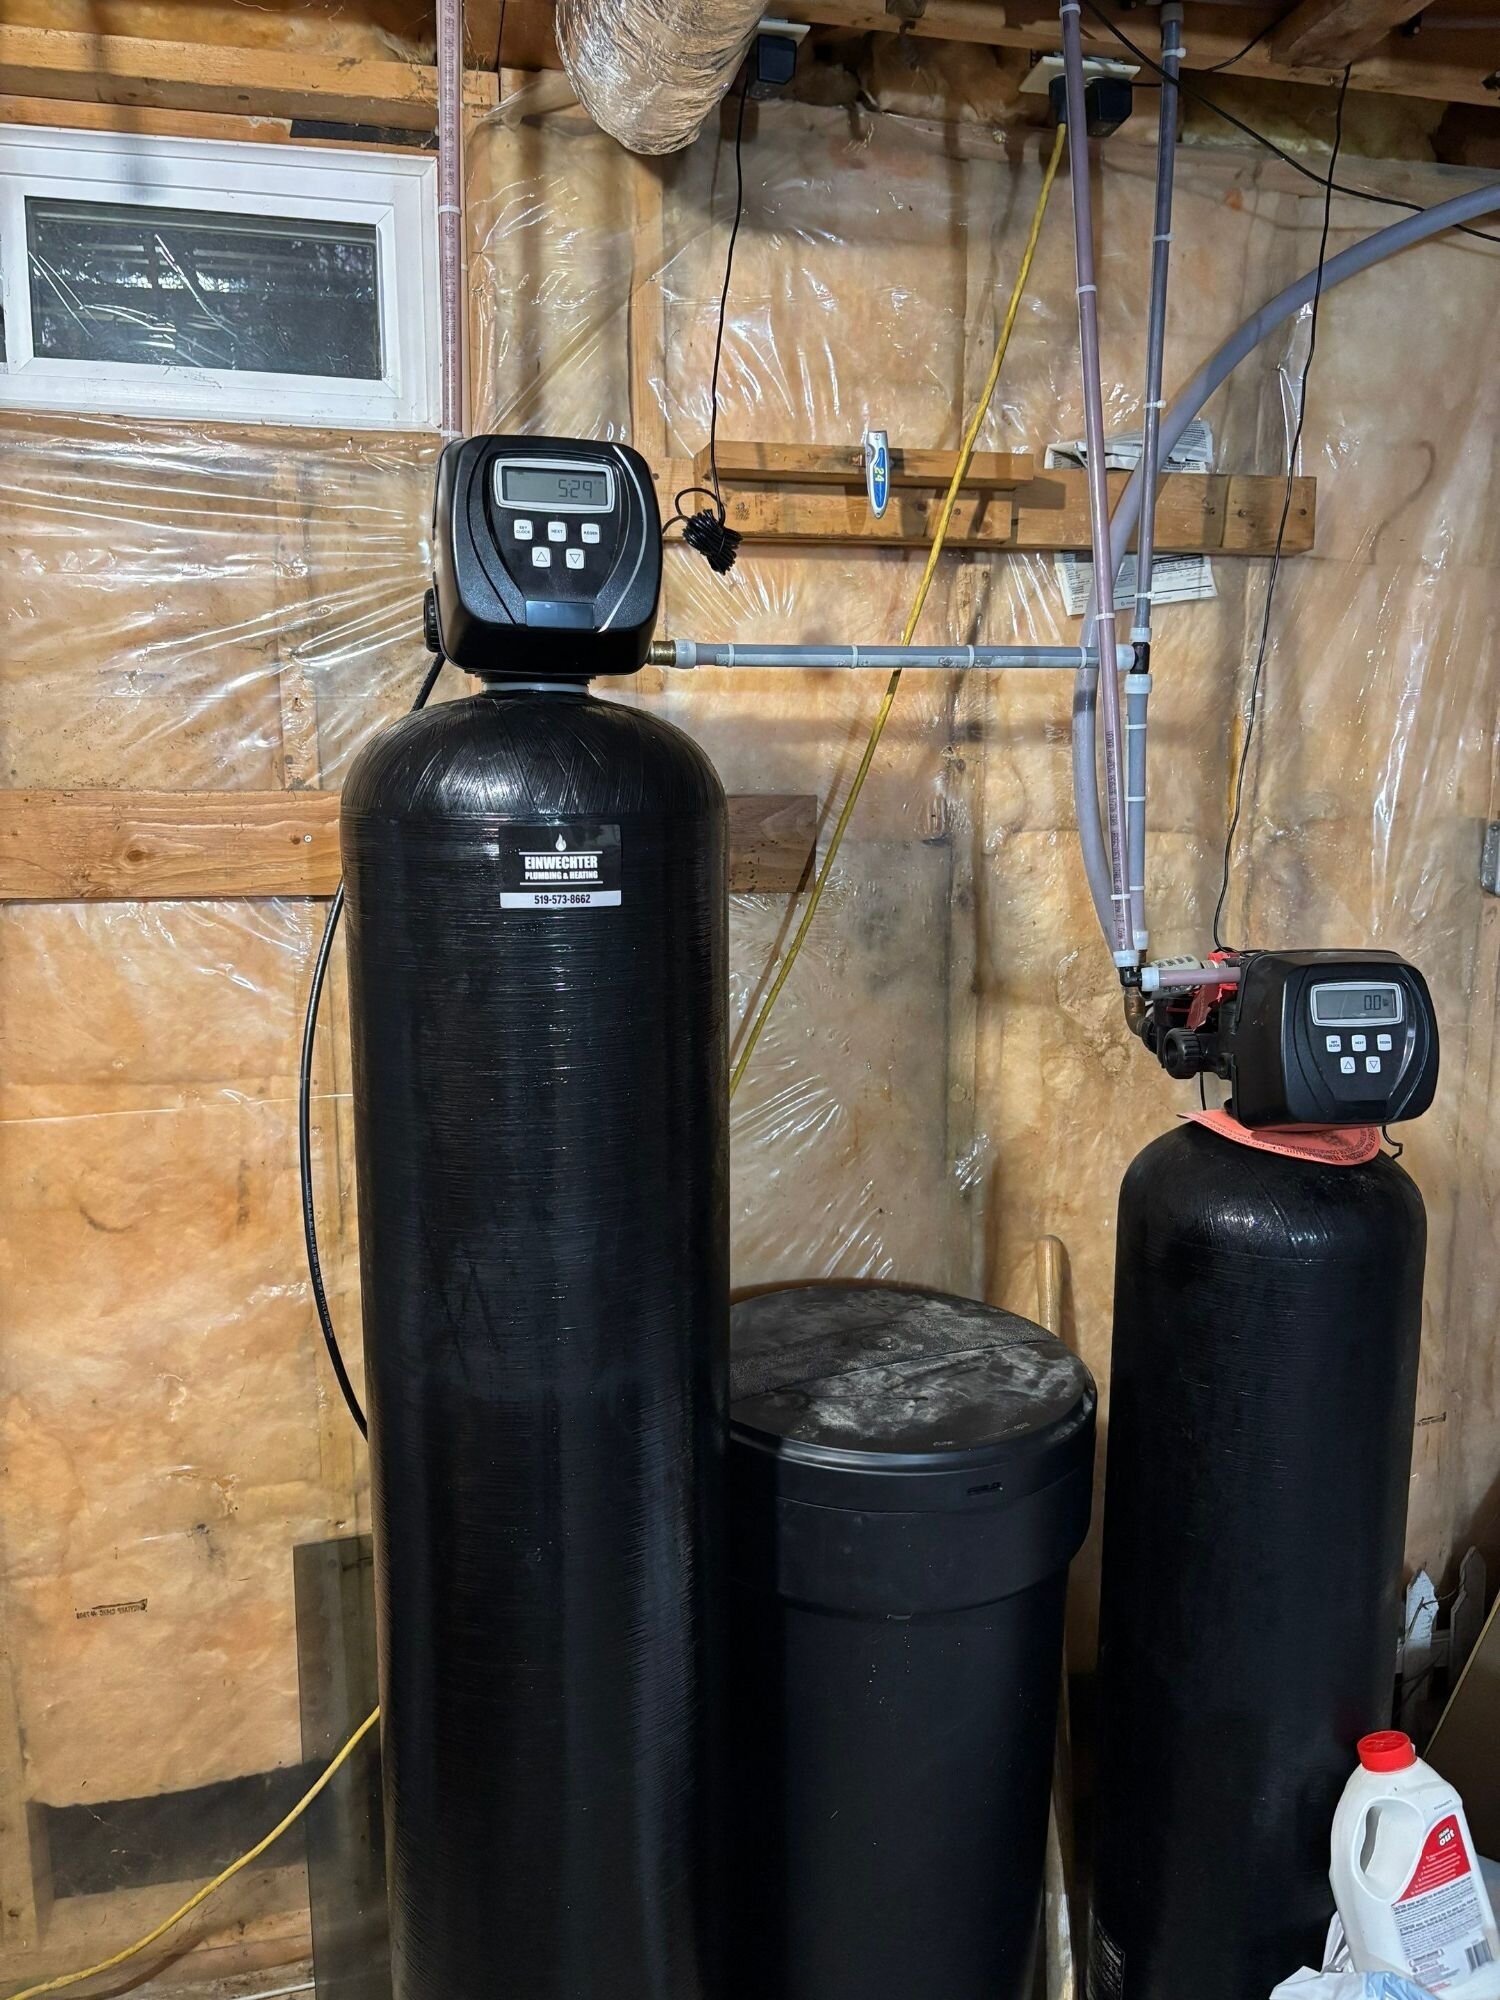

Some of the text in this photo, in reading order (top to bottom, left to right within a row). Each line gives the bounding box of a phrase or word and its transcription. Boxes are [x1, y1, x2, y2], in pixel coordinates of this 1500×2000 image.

[874, 466, 885, 482] 24
[524, 855, 598, 870] EINWECHTER
[525, 870, 598, 880] PLUMBING & HEATING
[534, 894, 591, 904] 519-573-8662
